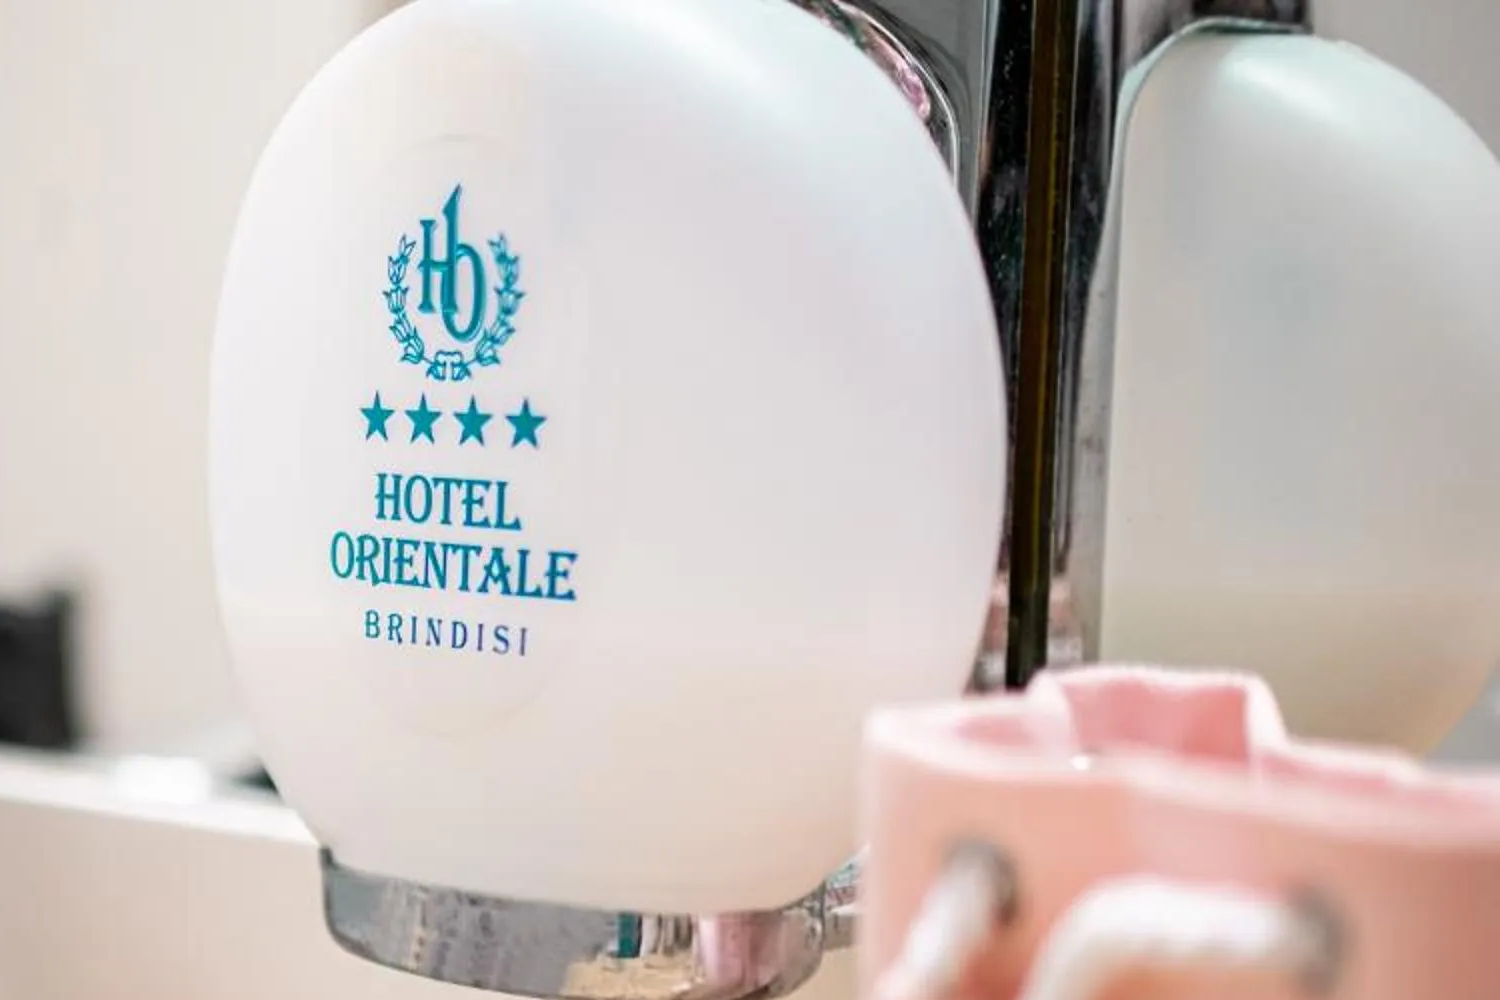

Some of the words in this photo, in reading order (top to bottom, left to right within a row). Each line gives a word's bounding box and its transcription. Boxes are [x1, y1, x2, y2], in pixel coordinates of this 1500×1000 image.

[374, 471, 522, 531] HOTEL
[329, 530, 579, 602] ORIENTALE
[364, 609, 529, 657] BRINDISI
